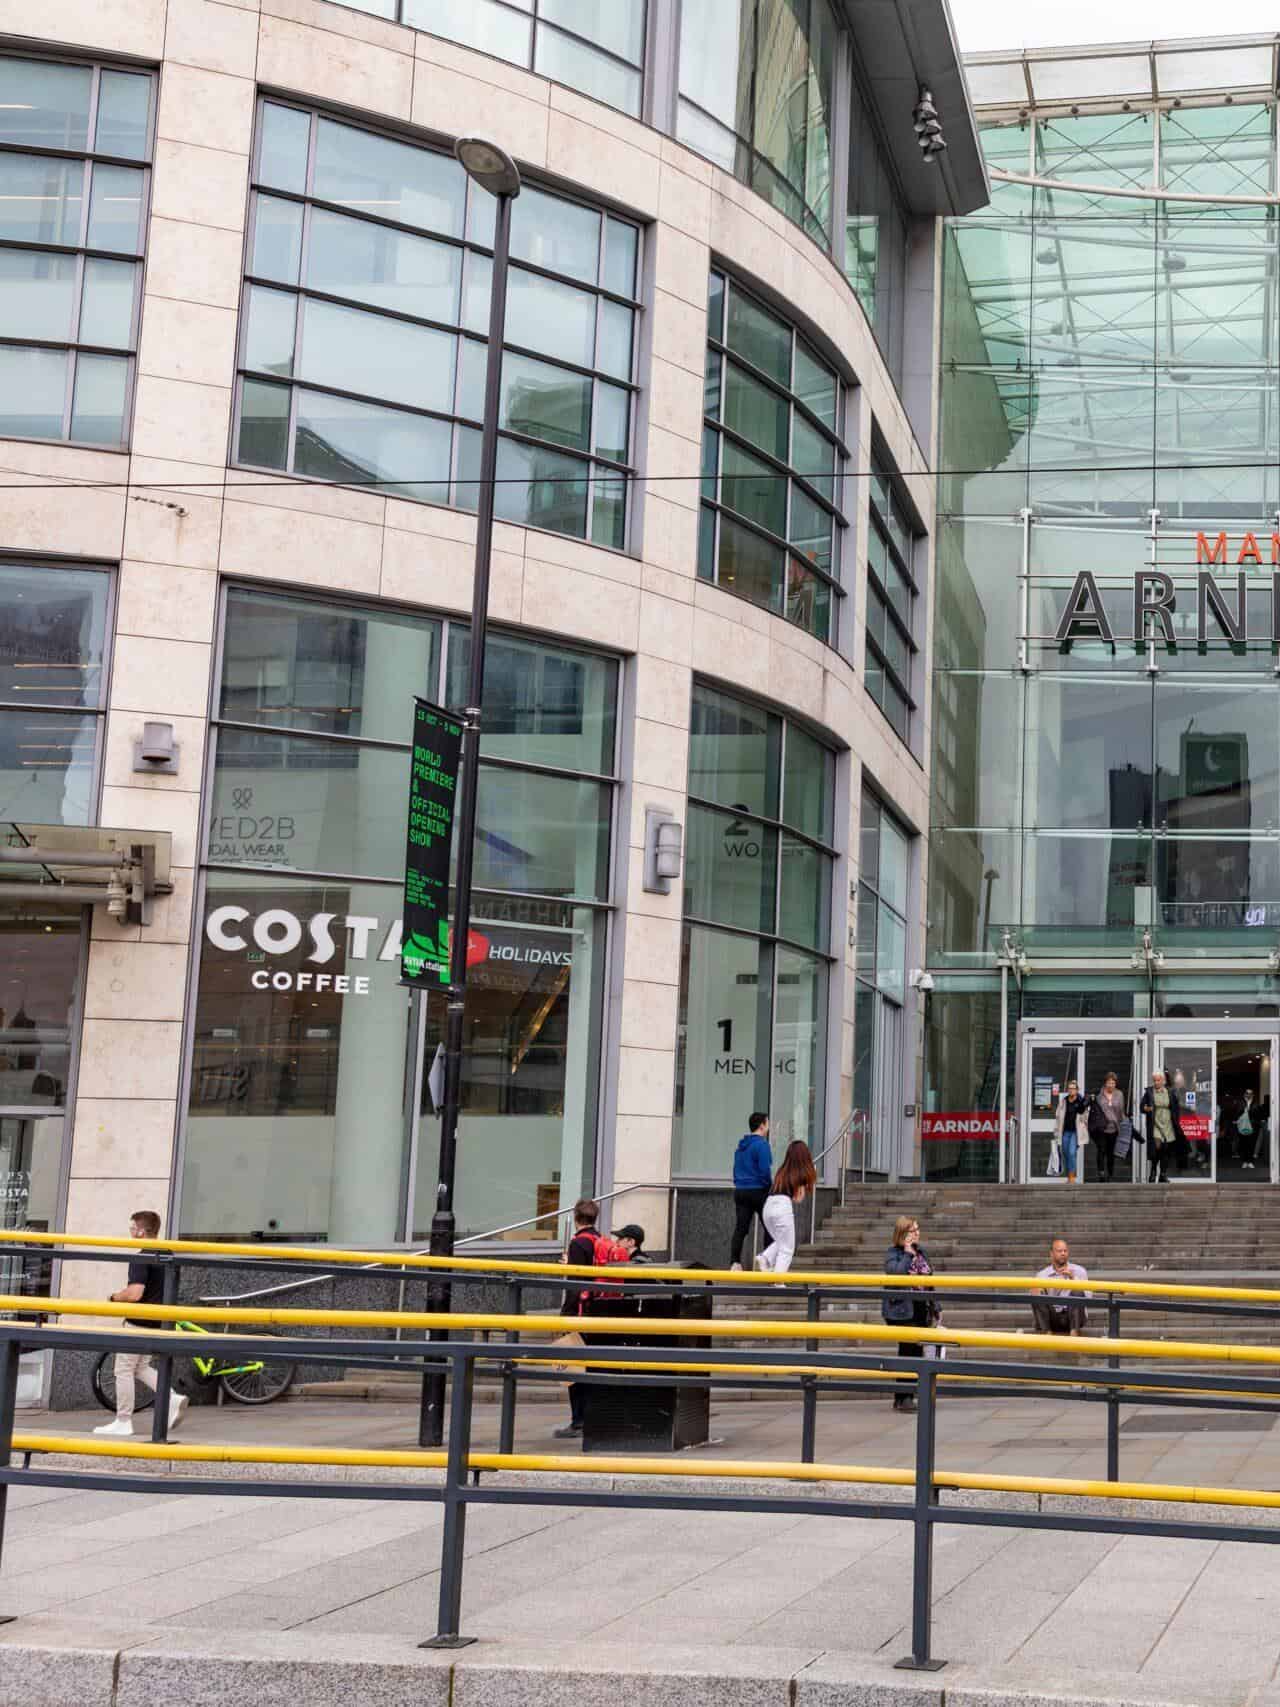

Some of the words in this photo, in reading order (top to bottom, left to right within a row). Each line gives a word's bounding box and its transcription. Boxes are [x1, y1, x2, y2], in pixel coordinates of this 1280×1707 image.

[414, 745, 442, 767] WORLD
[413, 762, 455, 791] PREMIERE
[411, 795, 451, 821] OFFICIAL
[410, 811, 446, 837] OPENING
[409, 828, 432, 848] SHOW
[244, 844, 285, 856] WEAR
[488, 945, 573, 966] HOLIDAYS
[251, 970, 370, 995] COFFEE
[717, 1018, 733, 1052] 1
[714, 1059, 757, 1074] MEN
